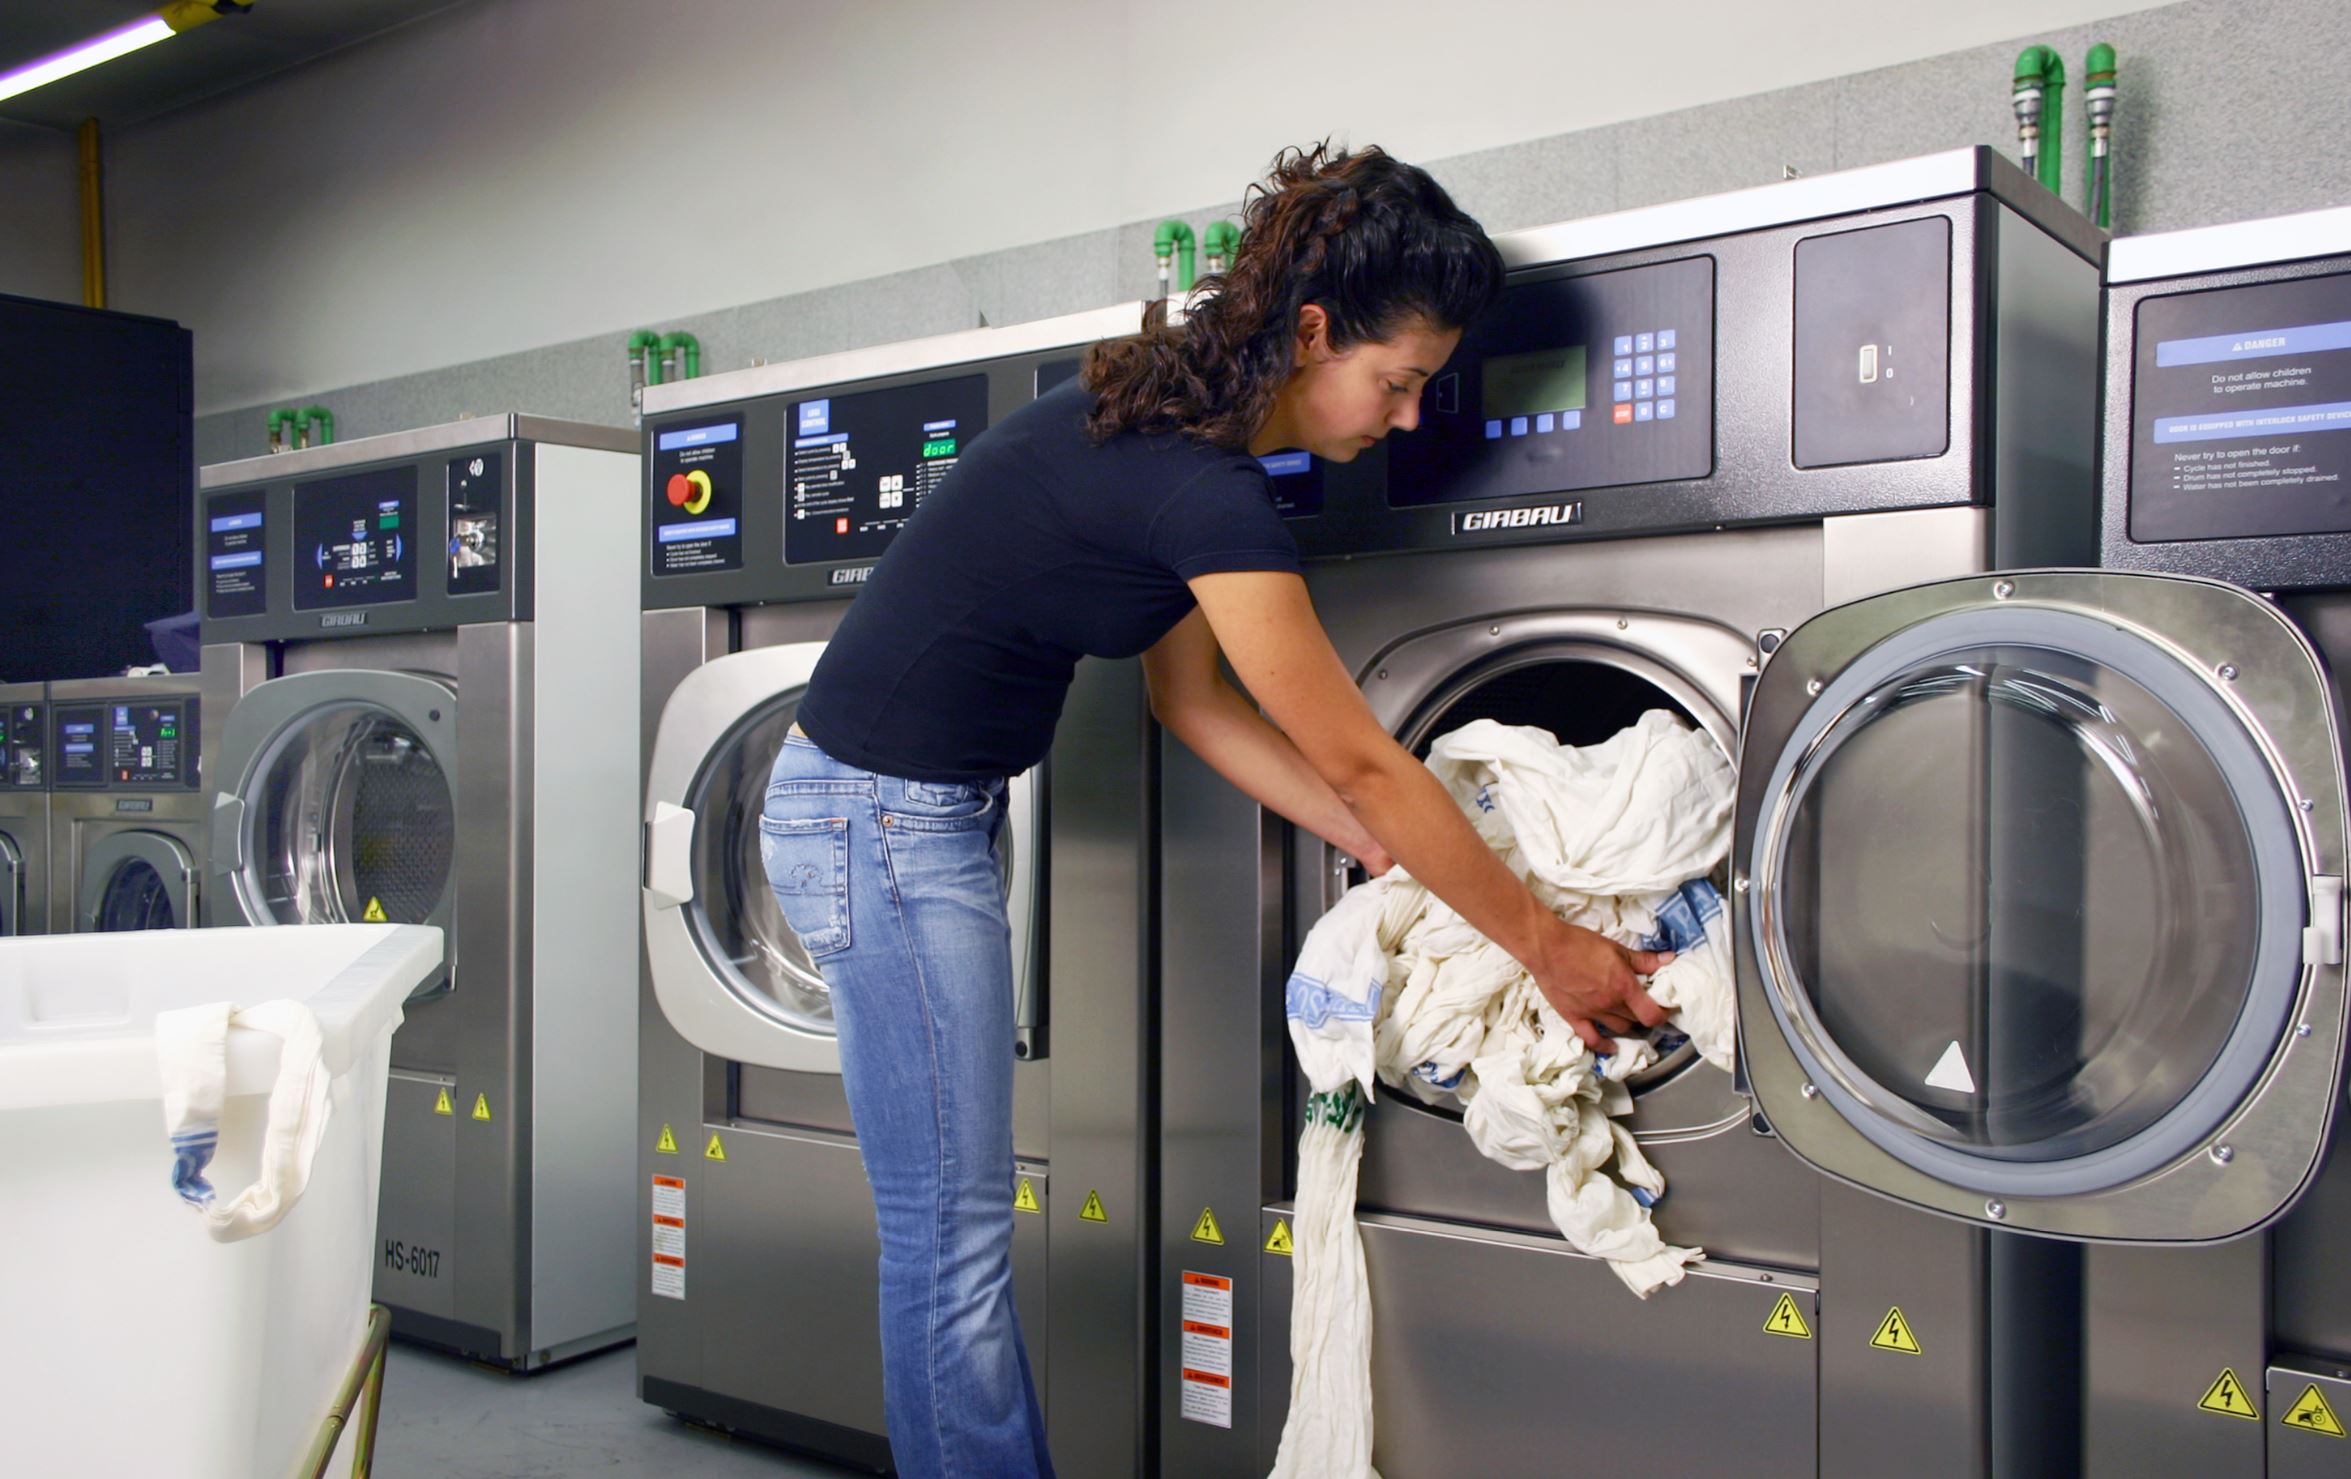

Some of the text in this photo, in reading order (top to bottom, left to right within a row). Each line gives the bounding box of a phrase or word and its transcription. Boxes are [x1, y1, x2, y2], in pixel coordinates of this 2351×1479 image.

[2244, 337, 2286, 350] DANGER
[2211, 367, 2312, 383] Do not allow children
[2213, 385, 2223, 394] to
[2224, 383, 2262, 394] operate
[923, 443, 954, 458] door
[2174, 453, 2201, 461] Never
[2202, 452, 2215, 461] try
[2216, 451, 2226, 459] to
[2227, 449, 2250, 458] open
[2252, 448, 2267, 456] the
[2269, 446, 2291, 455] door
[385, 1239, 440, 1278] HS-6017
